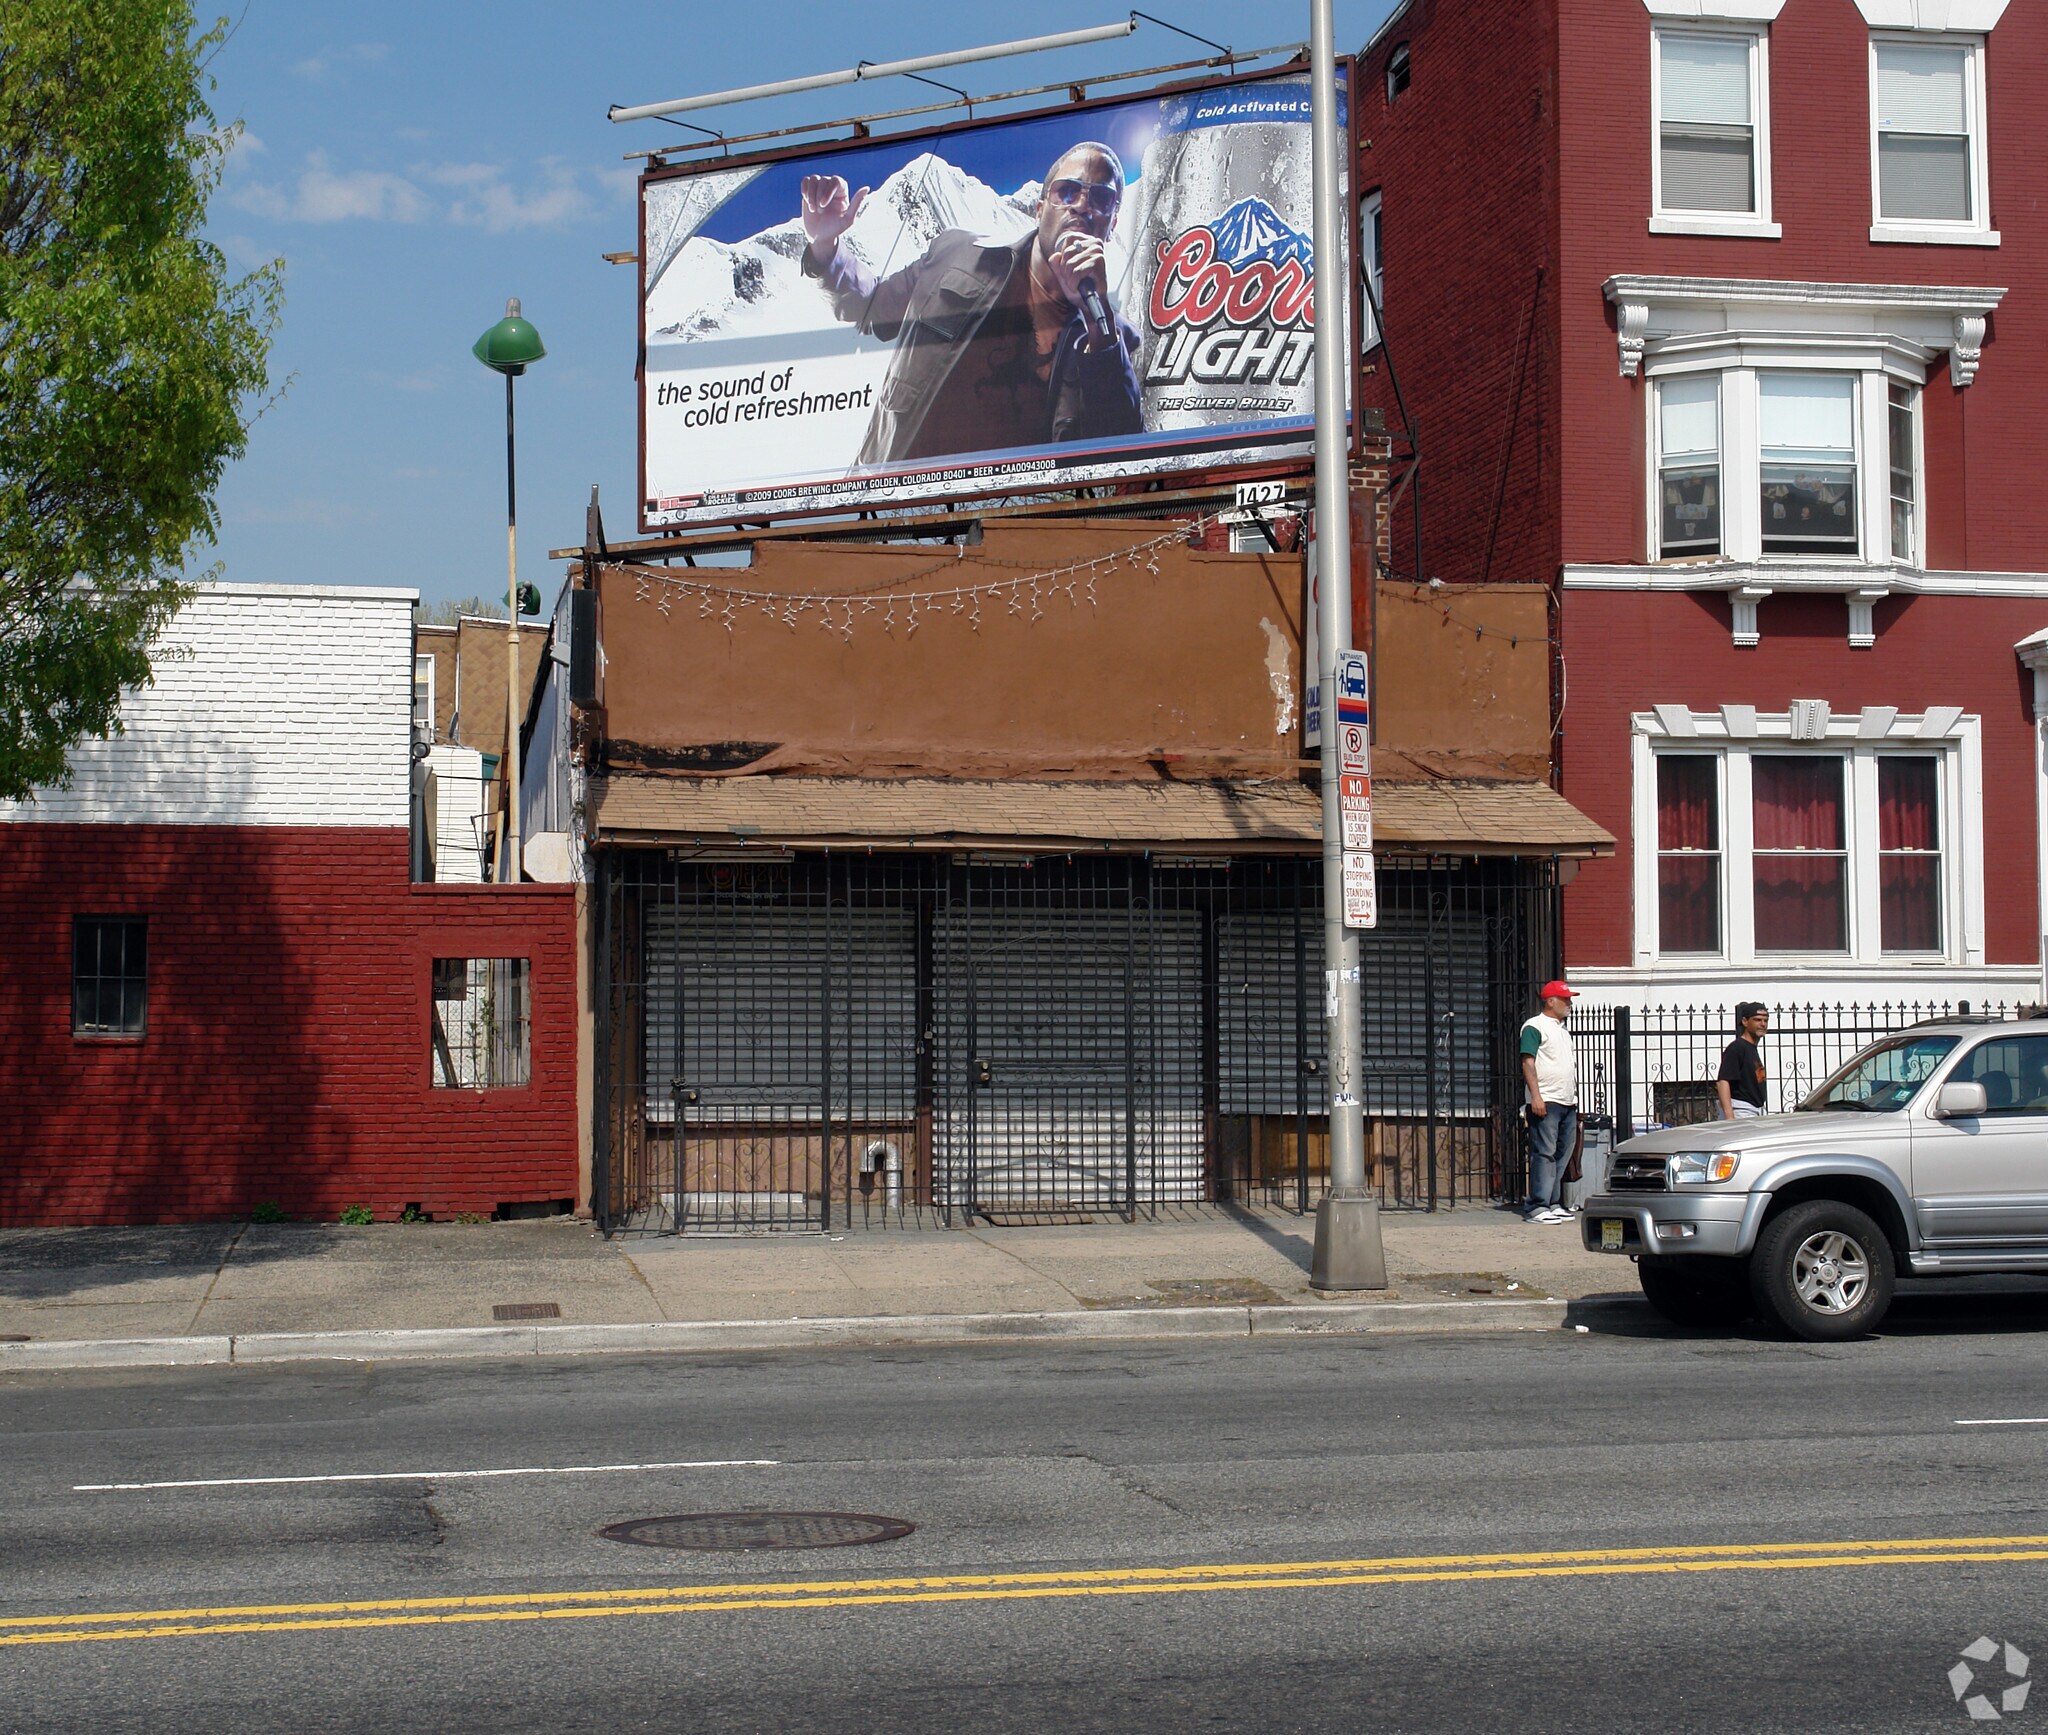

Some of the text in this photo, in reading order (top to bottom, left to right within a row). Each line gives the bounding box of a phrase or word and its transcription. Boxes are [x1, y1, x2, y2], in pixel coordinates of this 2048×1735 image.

[1197, 101, 1313, 119] Cold Activated C
[657, 366, 794, 406] the sound of
[684, 383, 873, 428] cold refreshment
[1157, 397, 1293, 411] THE SILVER BULLET
[773, 488, 796, 499] COORS
[798, 484, 831, 497] BREWING
[832, 479, 868, 493] COMPANY,
[902, 471, 941, 485] COLORADO
[943, 469, 966, 480] 80401
[973, 467, 993, 477] BEER
[1238, 484, 1283, 505] 1427
[707, 497, 736, 506] ROCKIES
[1343, 753, 1365, 763] BUS STOP
[1349, 779, 1362, 795] NO
[1343, 795, 1370, 811] PARKING
[1345, 812, 1369, 823] WHEN ROAD
[1348, 823, 1367, 833] IS SNOW
[1348, 833, 1368, 844] COVERED
[1352, 856, 1364, 869] NO
[1346, 870, 1372, 881] STOPPING
[1346, 887, 1373, 898] STANDING
